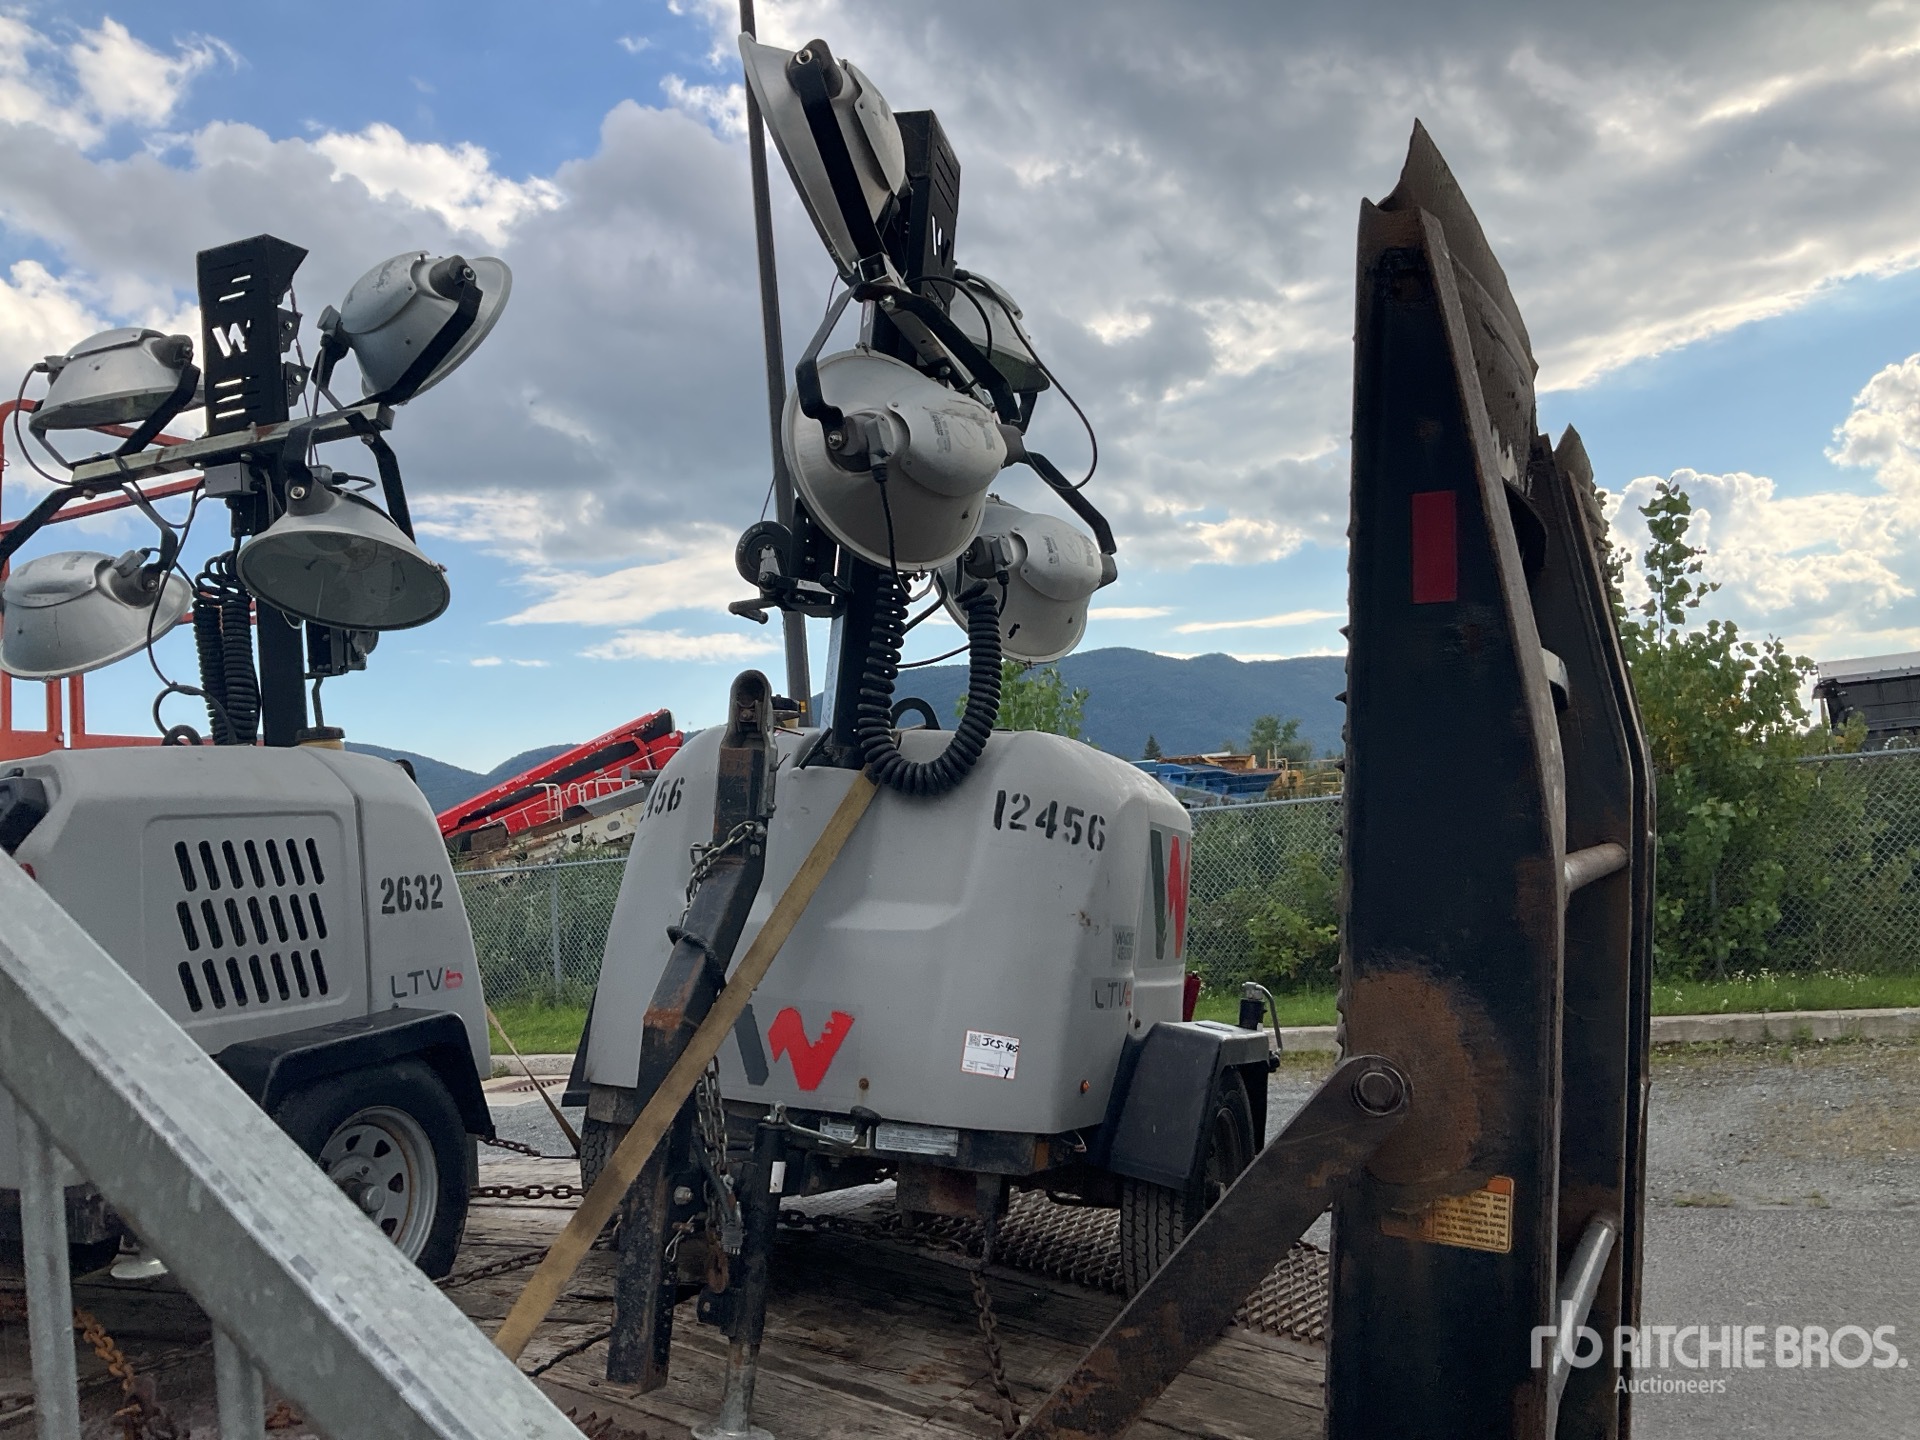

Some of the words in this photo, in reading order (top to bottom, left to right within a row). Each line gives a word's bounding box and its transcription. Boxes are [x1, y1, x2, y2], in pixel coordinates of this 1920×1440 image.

[640, 777, 685, 822] 456
[993, 790, 1106, 851] 12456
[381, 874, 443, 914] 2632
